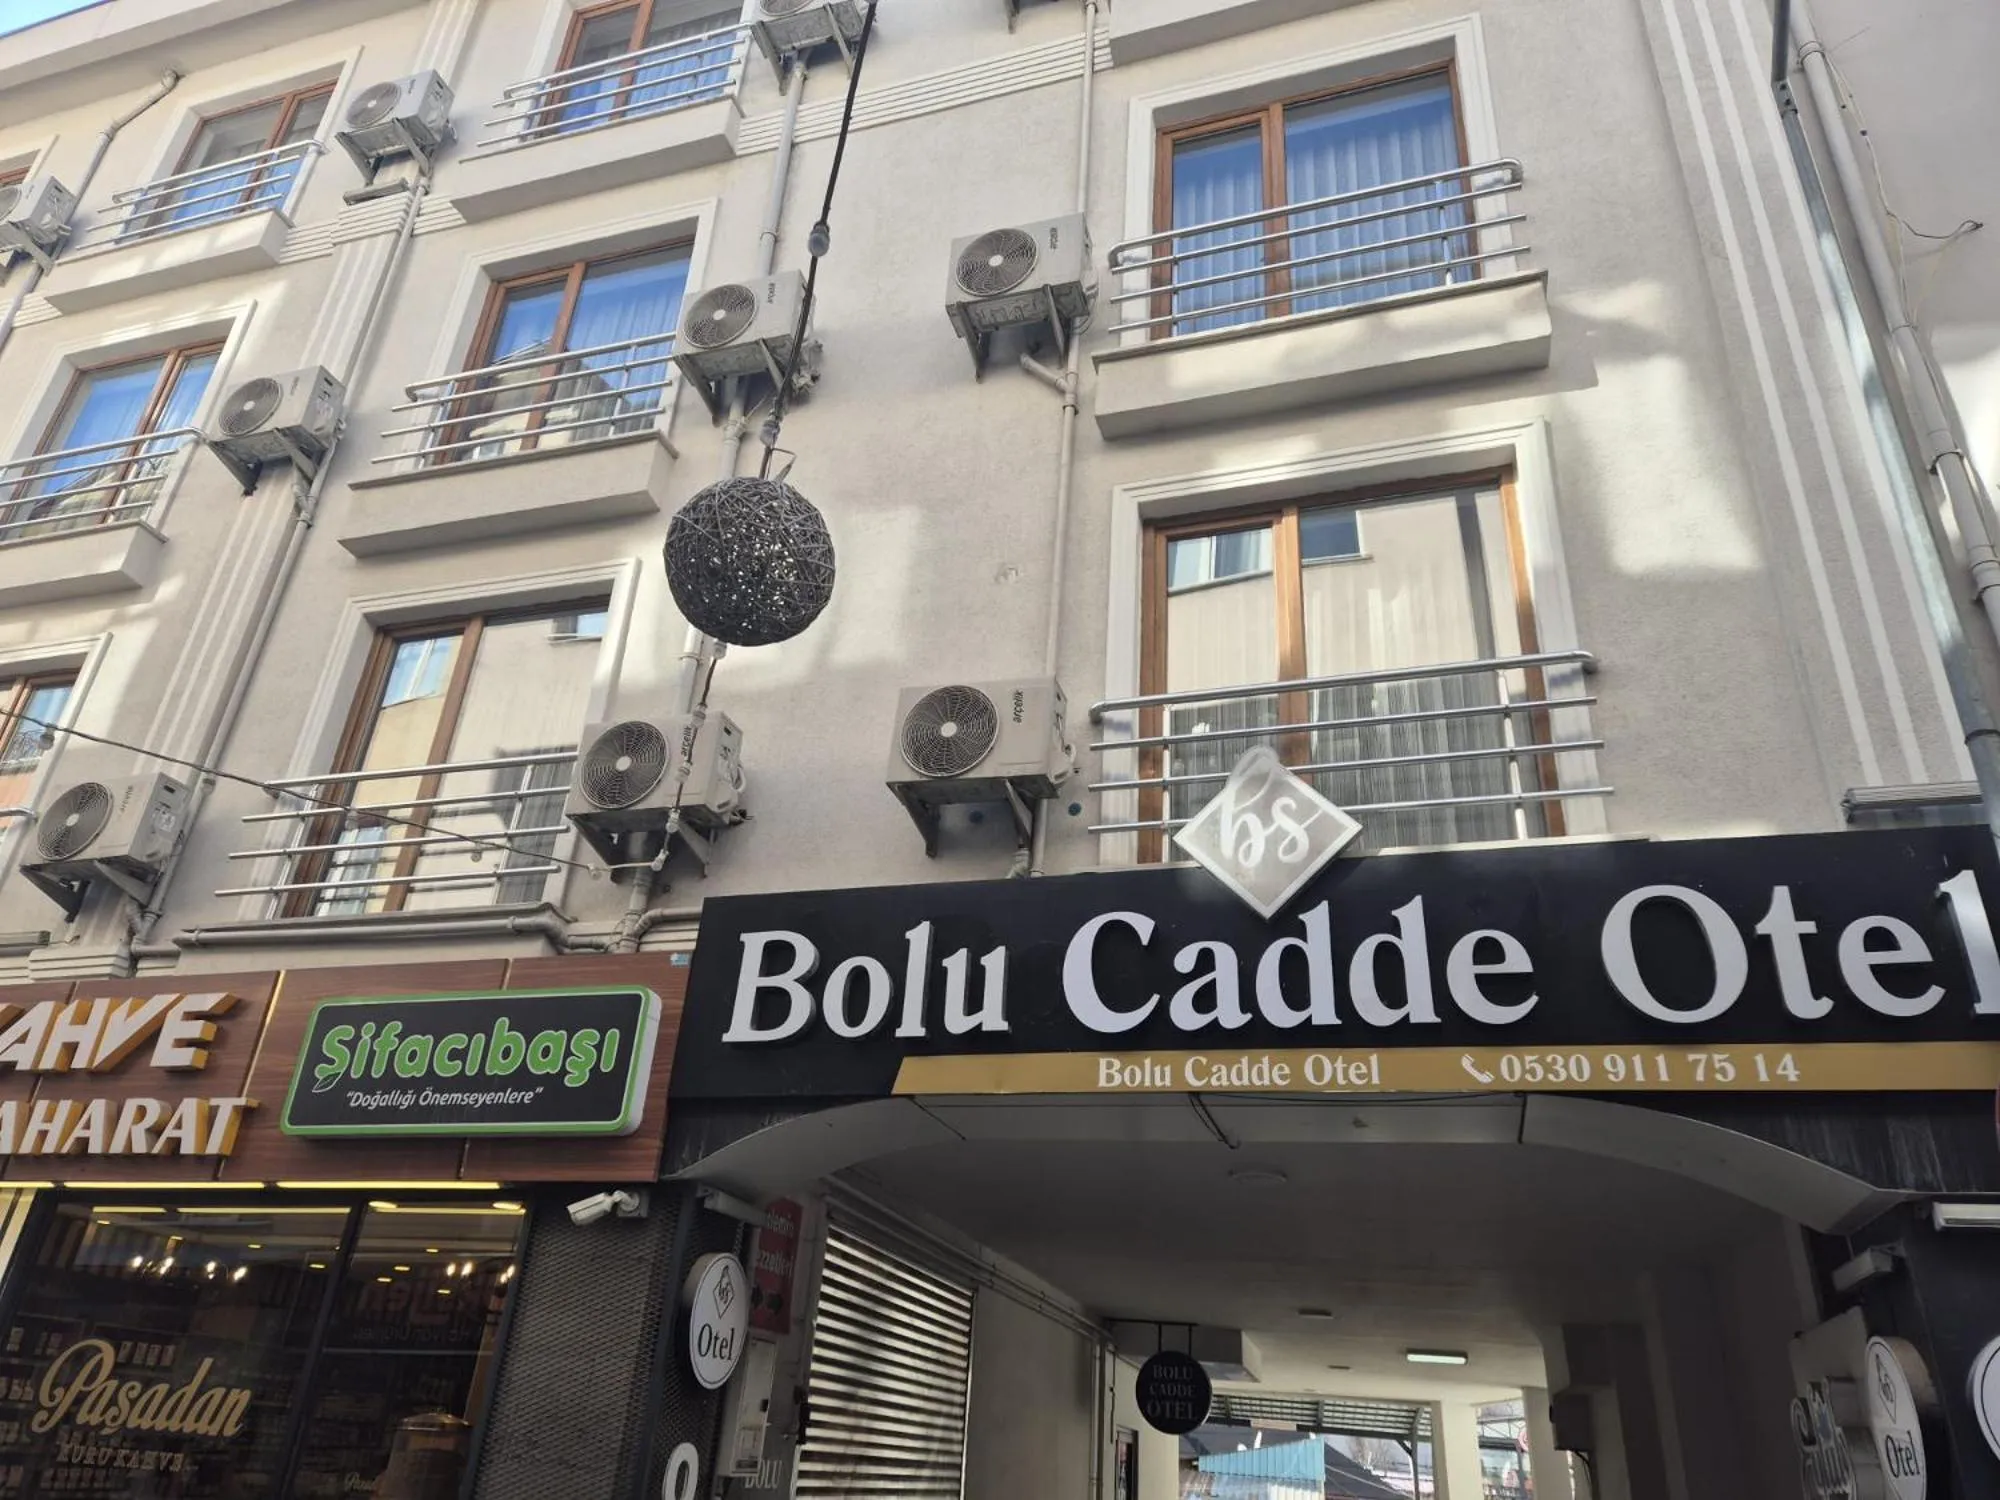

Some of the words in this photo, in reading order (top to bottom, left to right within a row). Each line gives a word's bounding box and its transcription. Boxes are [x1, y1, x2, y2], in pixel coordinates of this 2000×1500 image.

[722, 920, 1011, 1043] Bolu
[1062, 894, 1540, 1034] Cadde
[1600, 869, 2000, 1024] Otel
[0, 992, 241, 1072] AHVE
[1097, 1056, 1172, 1088] Bolu
[1184, 1055, 1292, 1088] Cadde
[1303, 1053, 1381, 1087] Otel
[1500, 1053, 1592, 1083] 0530
[1603, 1053, 1671, 1083] 911
[1687, 1053, 1737, 1083] 75
[1754, 1053, 1801, 1083] 14
[698, 1323, 734, 1361] Otel
[31, 1338, 252, 1437] Paşadan
[1885, 1430, 1920, 1478] Otel
